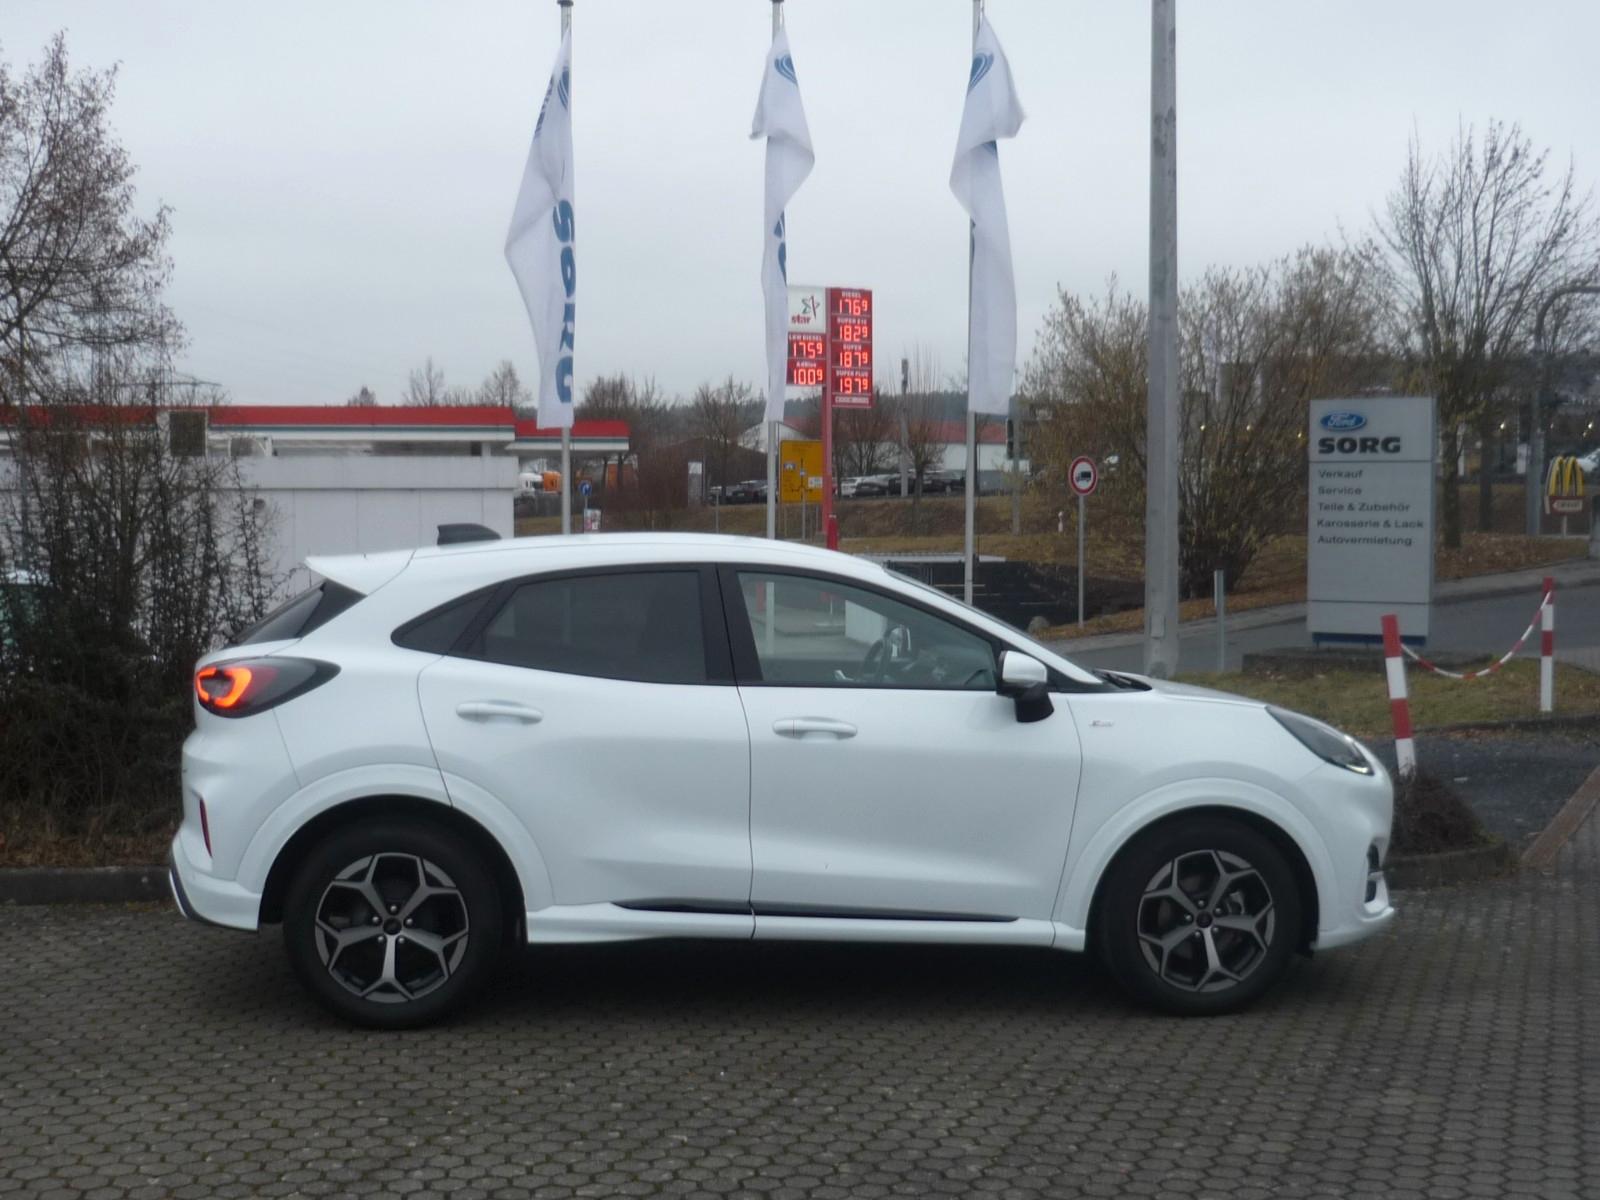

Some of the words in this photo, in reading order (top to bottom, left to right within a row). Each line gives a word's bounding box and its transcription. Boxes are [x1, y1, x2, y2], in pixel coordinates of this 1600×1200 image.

[791, 314, 812, 324] star
[1318, 437, 1401, 454] SORG
[1318, 469, 1363, 479] Verkauf
[1318, 486, 1362, 495] Service
[1318, 502, 1344, 512] Teile
[1347, 502, 1355, 512] &
[1358, 502, 1411, 512] Zubehör
[1317, 519, 1380, 528] Karosserie
[1383, 519, 1391, 529] &
[1394, 519, 1424, 529] Lack
[1317, 535, 1412, 547] Autovermietung
